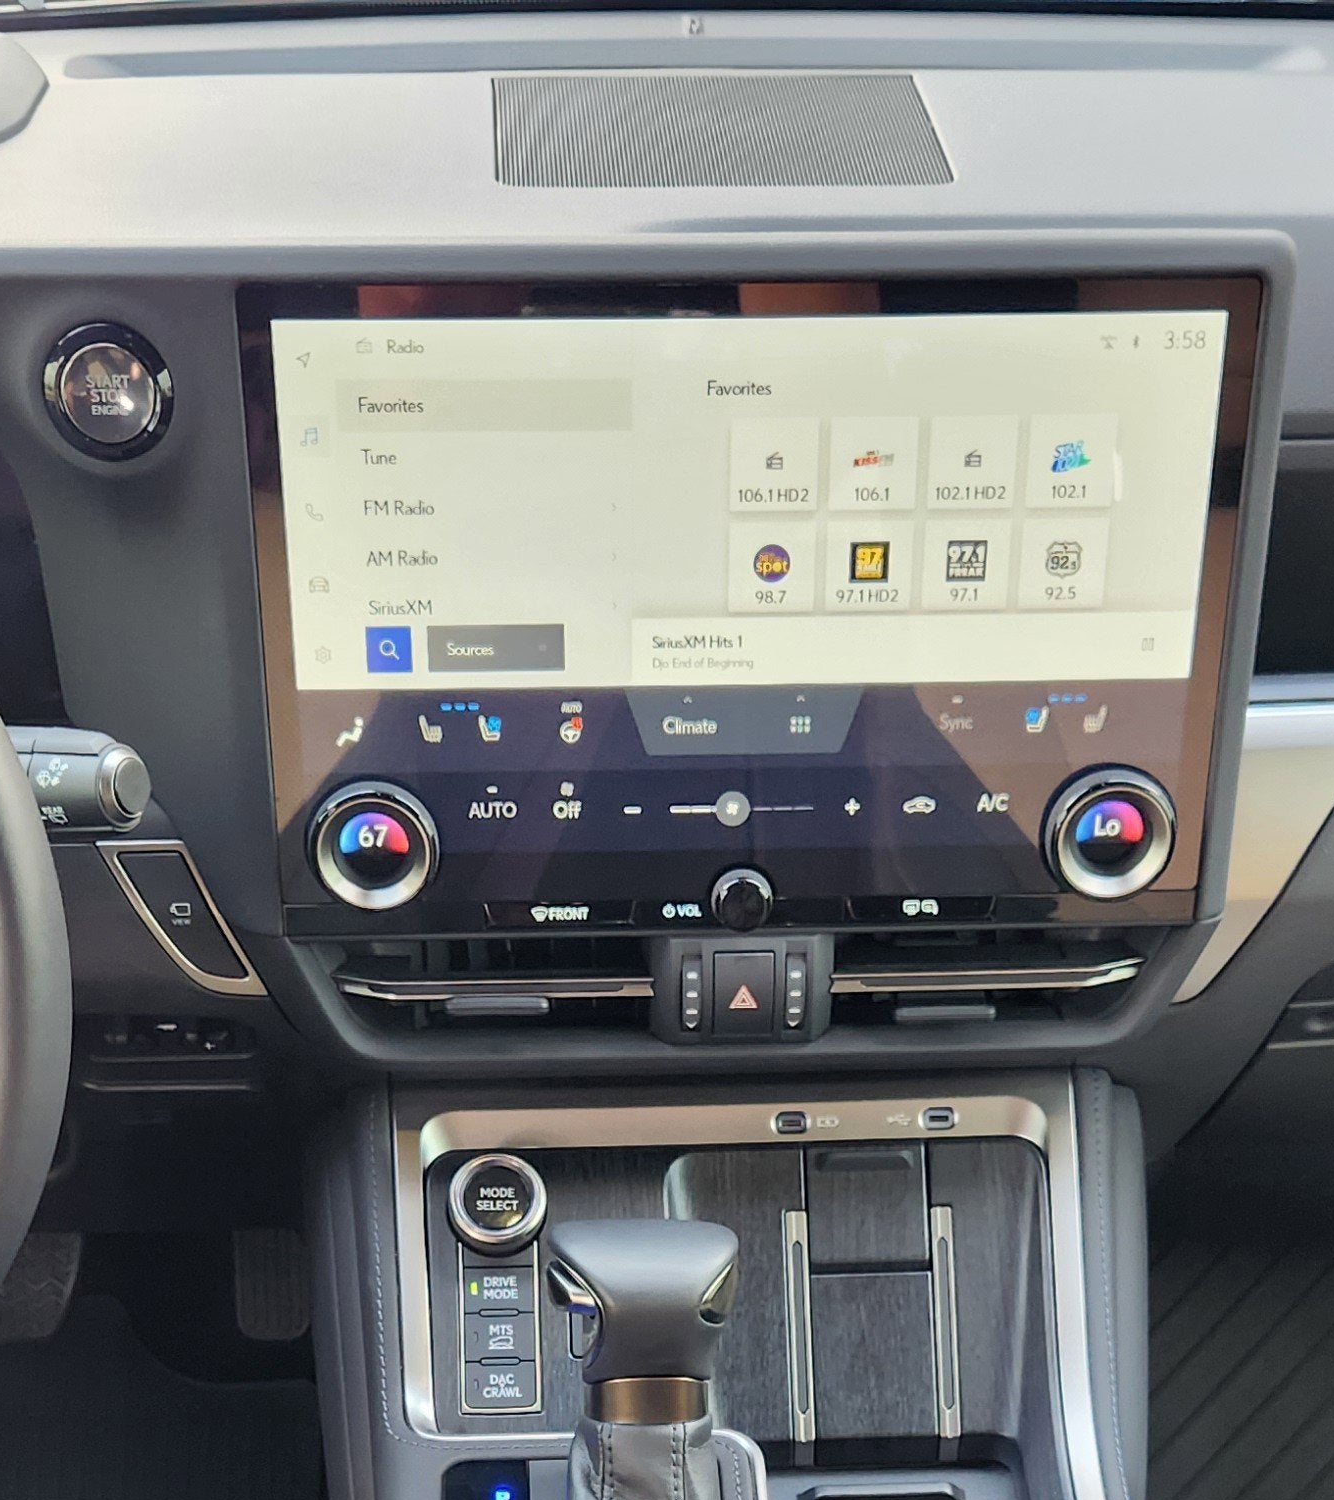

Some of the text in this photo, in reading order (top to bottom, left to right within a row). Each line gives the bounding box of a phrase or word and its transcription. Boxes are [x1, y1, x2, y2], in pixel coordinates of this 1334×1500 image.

[386, 339, 424, 354] Radio
[1163, 330, 1207, 350] 3:58
[85, 375, 130, 389] START
[706, 379, 772, 396] Favorites
[357, 396, 424, 414] Favorites
[361, 448, 397, 466] Tune
[738, 488, 773, 504] 106.1
[855, 487, 890, 502] 106.1
[935, 486, 971, 501] 102.1
[1052, 484, 1087, 499] 102.1
[364, 500, 435, 517] FM Radio
[367, 550, 439, 567] AM Radio
[755, 560, 789, 577] spot
[754, 590, 787, 604] 98.7
[835, 589, 865, 604] 97.1
[949, 588, 979, 602] 97.1
[1045, 586, 1076, 601] 92.5
[368, 599, 433, 616] SiriusXM
[446, 641, 496, 658] Sources
[652, 635, 744, 650] SiriusXM Hits 1
[662, 715, 718, 735] Climate
[938, 712, 974, 733] Sync
[467, 800, 518, 820] AUTO
[976, 793, 1010, 812] A/C
[551, 801, 583, 820] Off
[1093, 815, 1121, 837] Lo
[357, 824, 389, 849] 67
[547, 906, 590, 921] FRONT
[676, 903, 703, 918] VOL
[479, 1187, 516, 1199] MODE
[475, 1199, 520, 1211] SELECT
[483, 1276, 518, 1287] DRIVE
[483, 1289, 519, 1299] MODE
[489, 1324, 514, 1336] MTS
[489, 1374, 515, 1386] DAC
[483, 1386, 523, 1398] CRAWL
